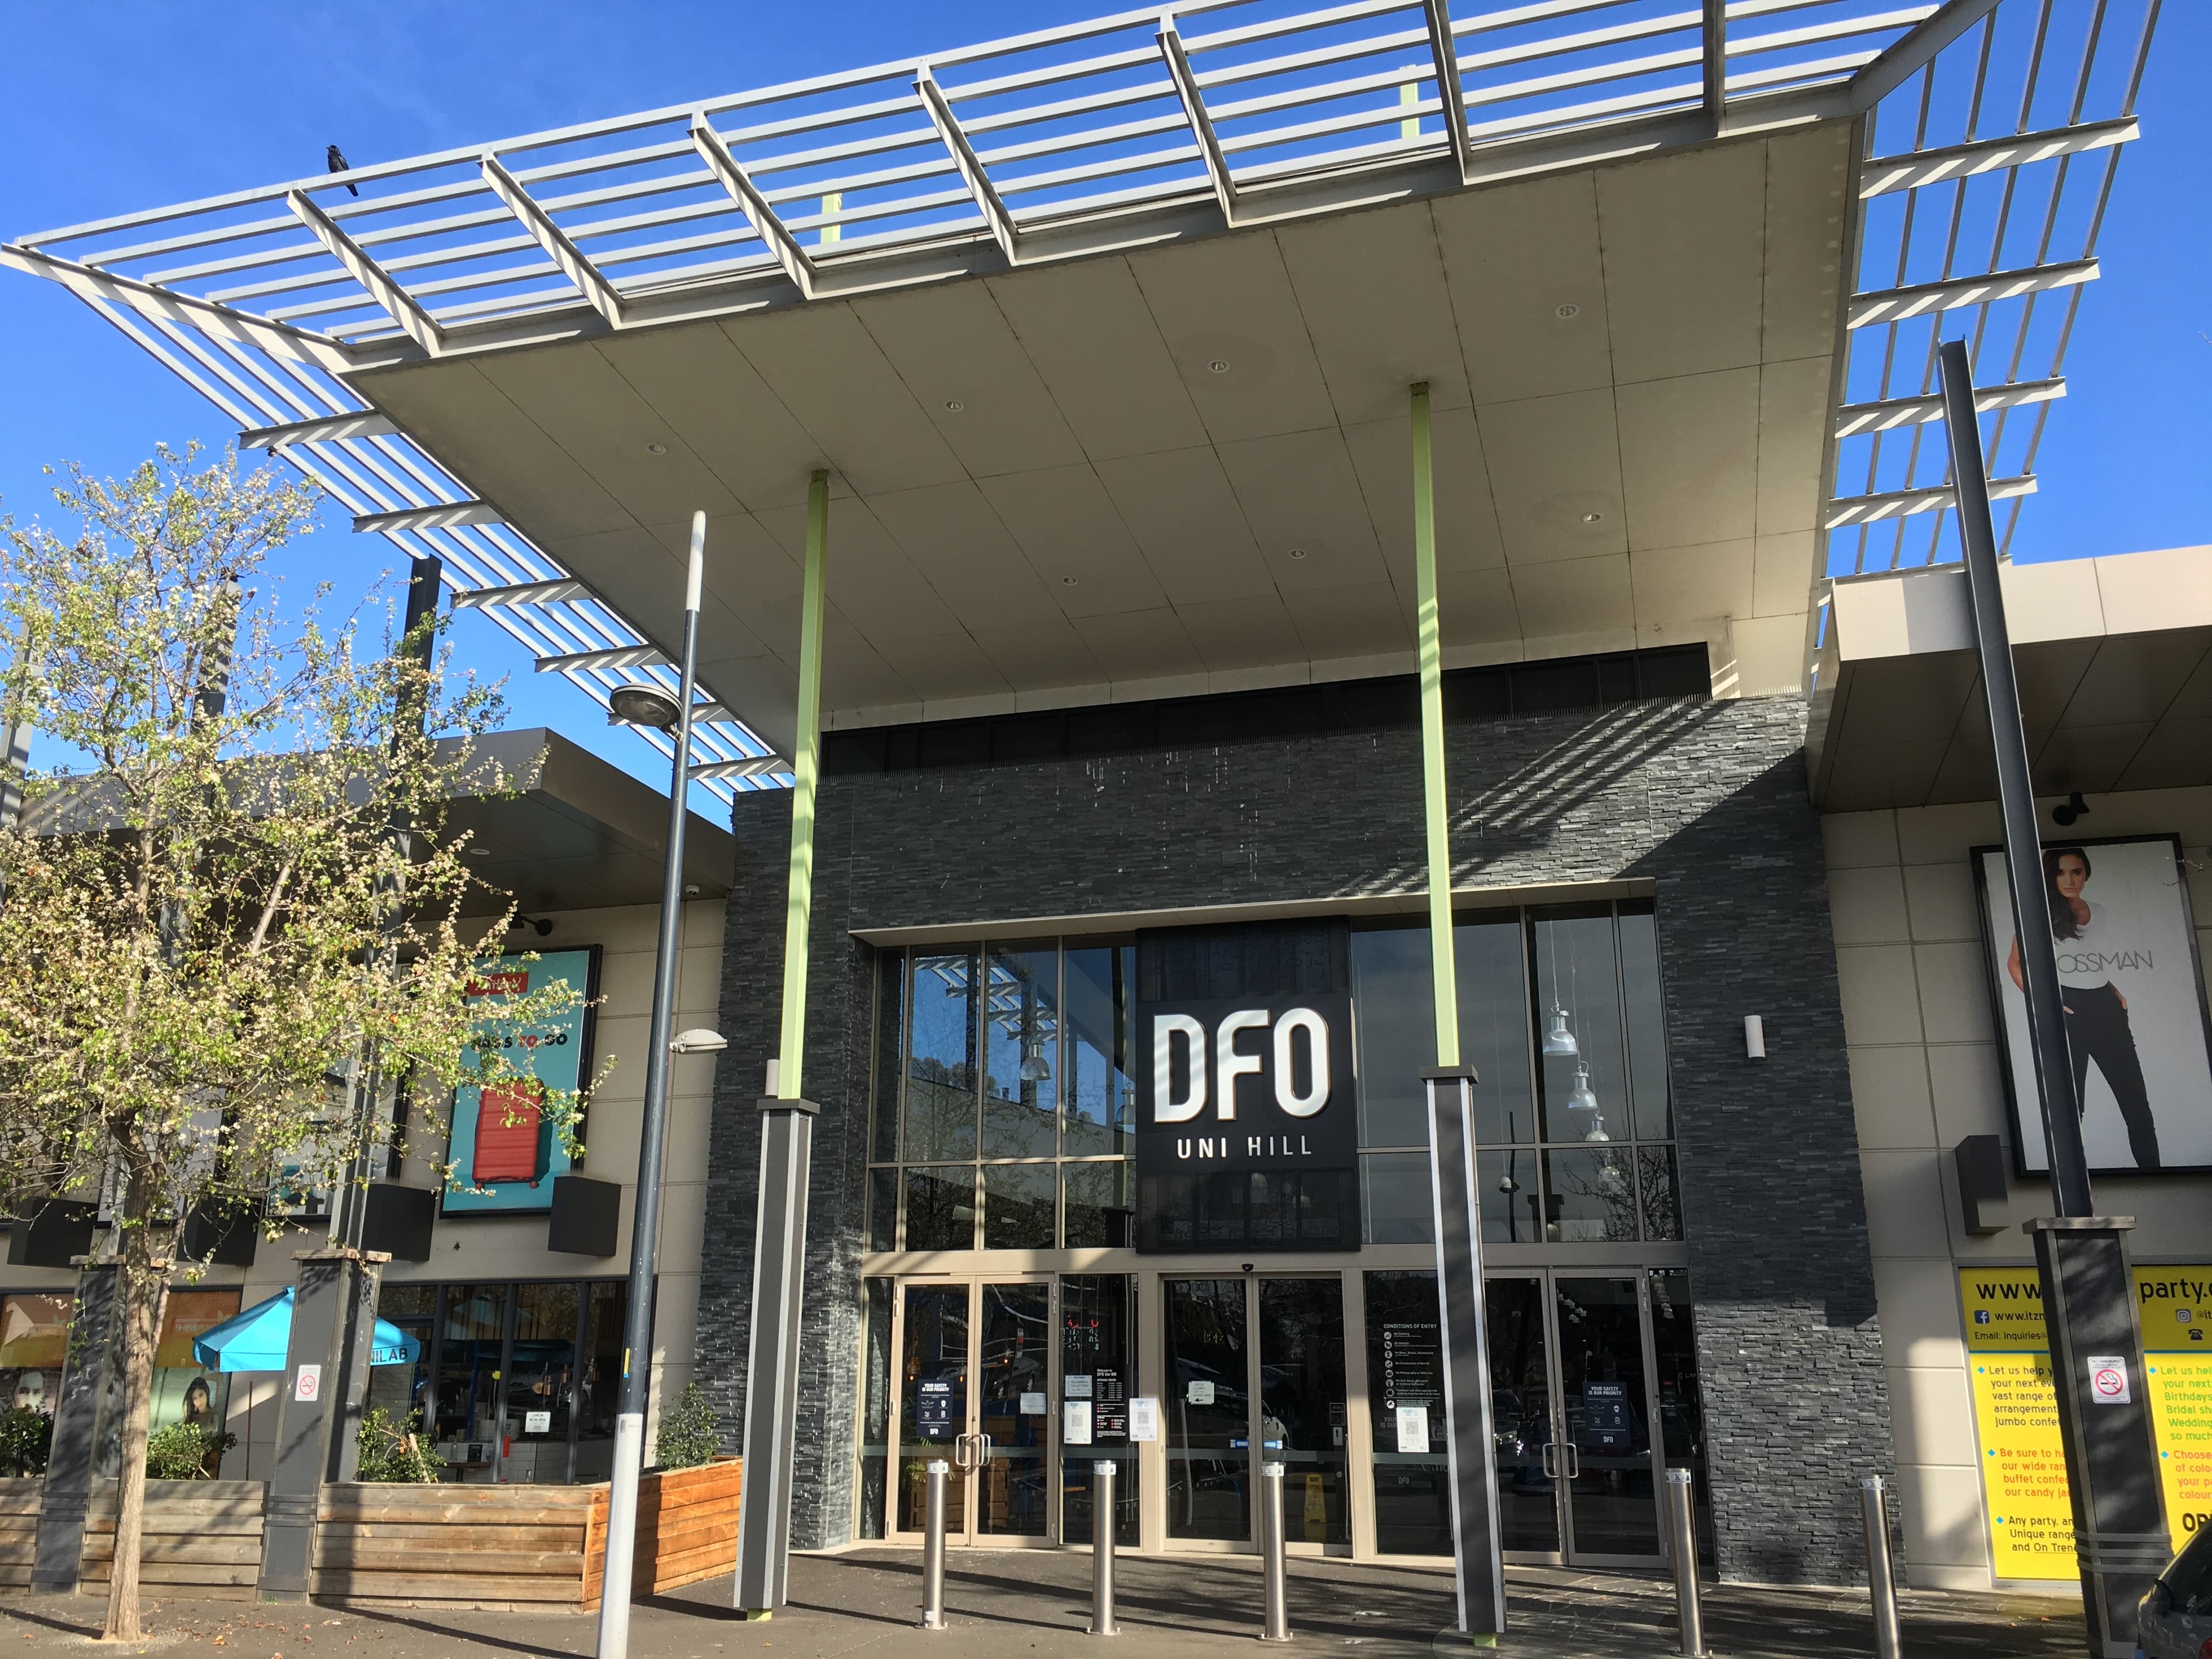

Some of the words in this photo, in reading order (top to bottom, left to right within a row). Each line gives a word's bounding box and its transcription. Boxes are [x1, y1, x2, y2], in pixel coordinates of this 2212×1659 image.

[520, 1035, 538, 1048] TO
[544, 1034, 568, 1046] GO
[1154, 1007, 1331, 1124] DFO
[1177, 1137, 1226, 1159] UNI
[1248, 1135, 1312, 1156] HILL
[1975, 1332, 2001, 1340] Email:
[1989, 1366, 2005, 1374] Let
[2024, 1366, 2044, 1377] help
[2161, 1366, 2177, 1374] Let
[2196, 1366, 2212, 1375] hel
[1991, 1380, 2012, 1389] your
[2016, 1379, 2037, 1387] next
[2162, 1381, 2184, 1389] your
[2189, 1380, 2212, 1388] next
[1992, 1392, 2012, 1400] vast
[2016, 1393, 2043, 1402] range
[2165, 1392, 2212, 1403] Birthdays
[2166, 1405, 2196, 1414] Bridal
[1995, 1417, 2026, 1427] jumbo
[2000, 1448, 2013, 1457] Be
[2041, 1449, 2051, 1457] to
[2173, 1450, 2212, 1459] Choose
[2022, 1461, 2046, 1470] wide
[2176, 1463, 2185, 1472] of
[2003, 1474, 2033, 1483] buffet
[2177, 1478, 2199, 1487] your
[2025, 1488, 2054, 1499] candy
[2009, 1516, 2026, 1527] Any
[2182, 1510, 2212, 1532] OP
[2010, 1529, 2044, 1540] Unique
[2049, 1532, 2075, 1541] range
[2012, 1543, 2030, 1551] and
[2034, 1543, 2047, 1552] On
